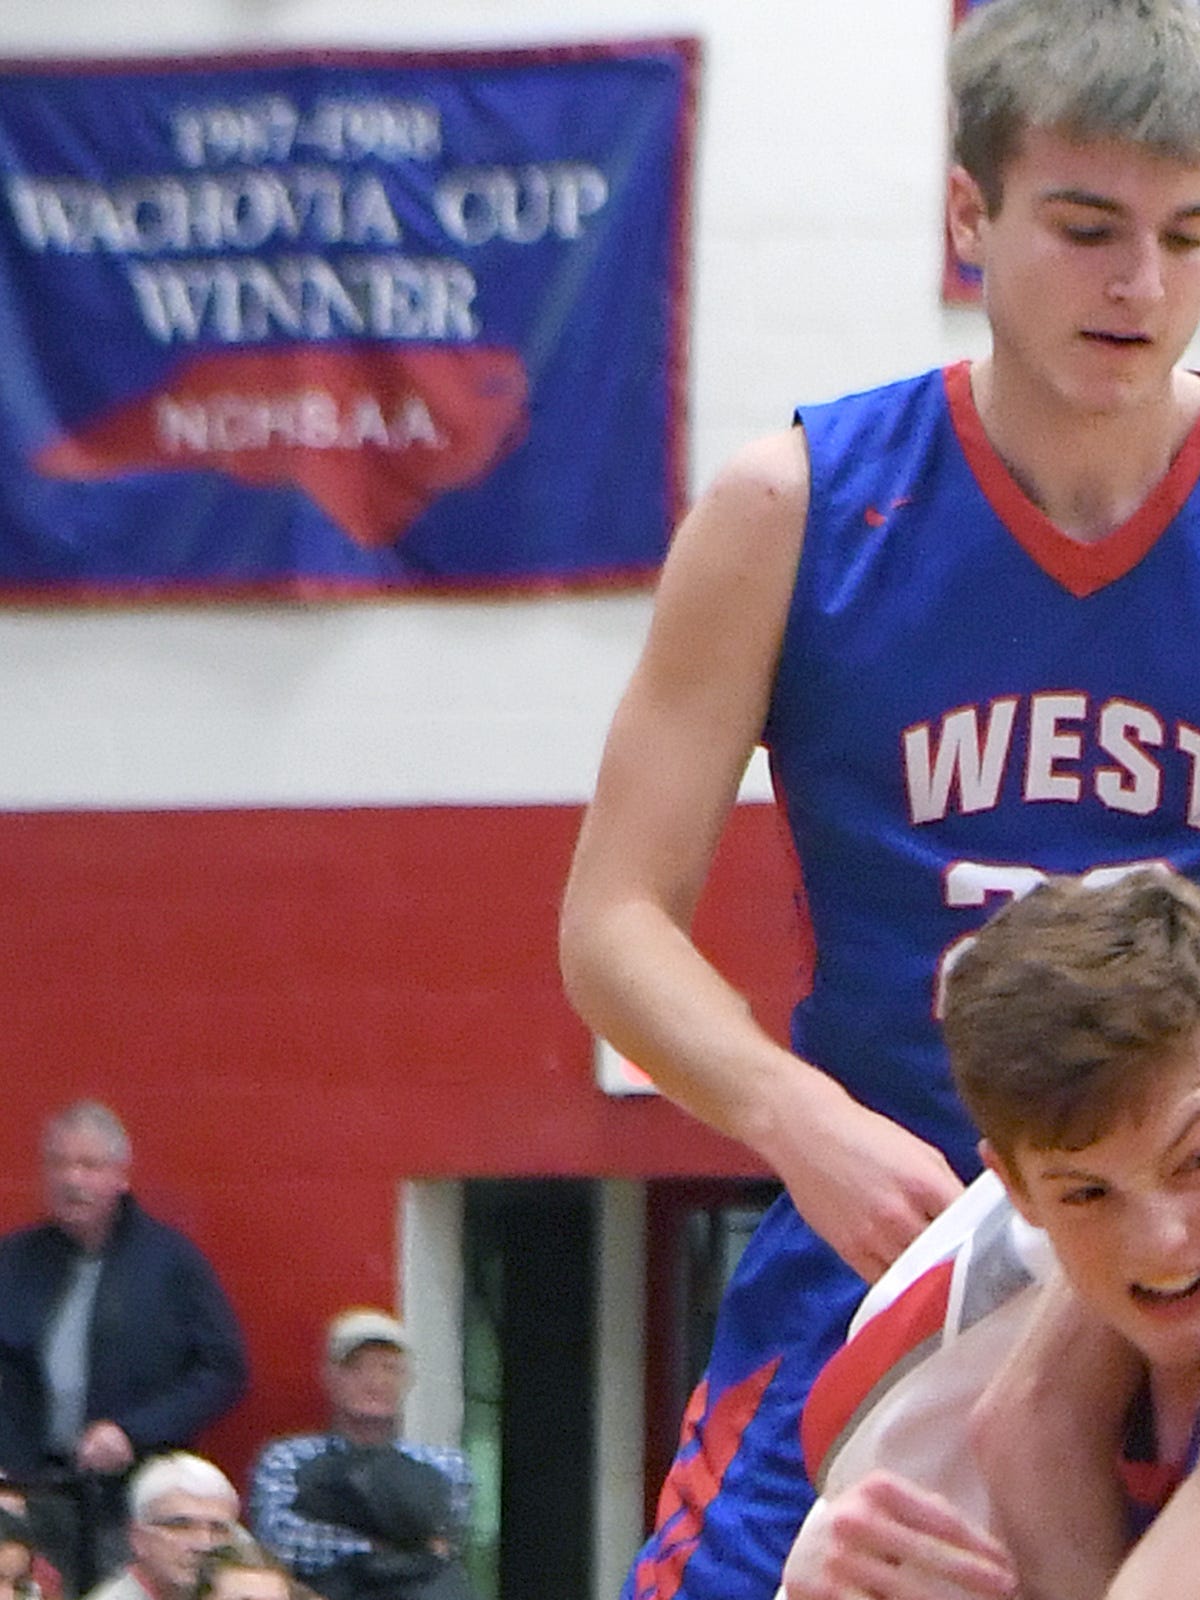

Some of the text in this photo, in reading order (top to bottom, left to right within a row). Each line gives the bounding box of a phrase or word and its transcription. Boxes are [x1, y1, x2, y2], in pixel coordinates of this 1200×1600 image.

[8, 160, 609, 254] WACHOVIA CUP
[130, 254, 483, 345] WINNER
